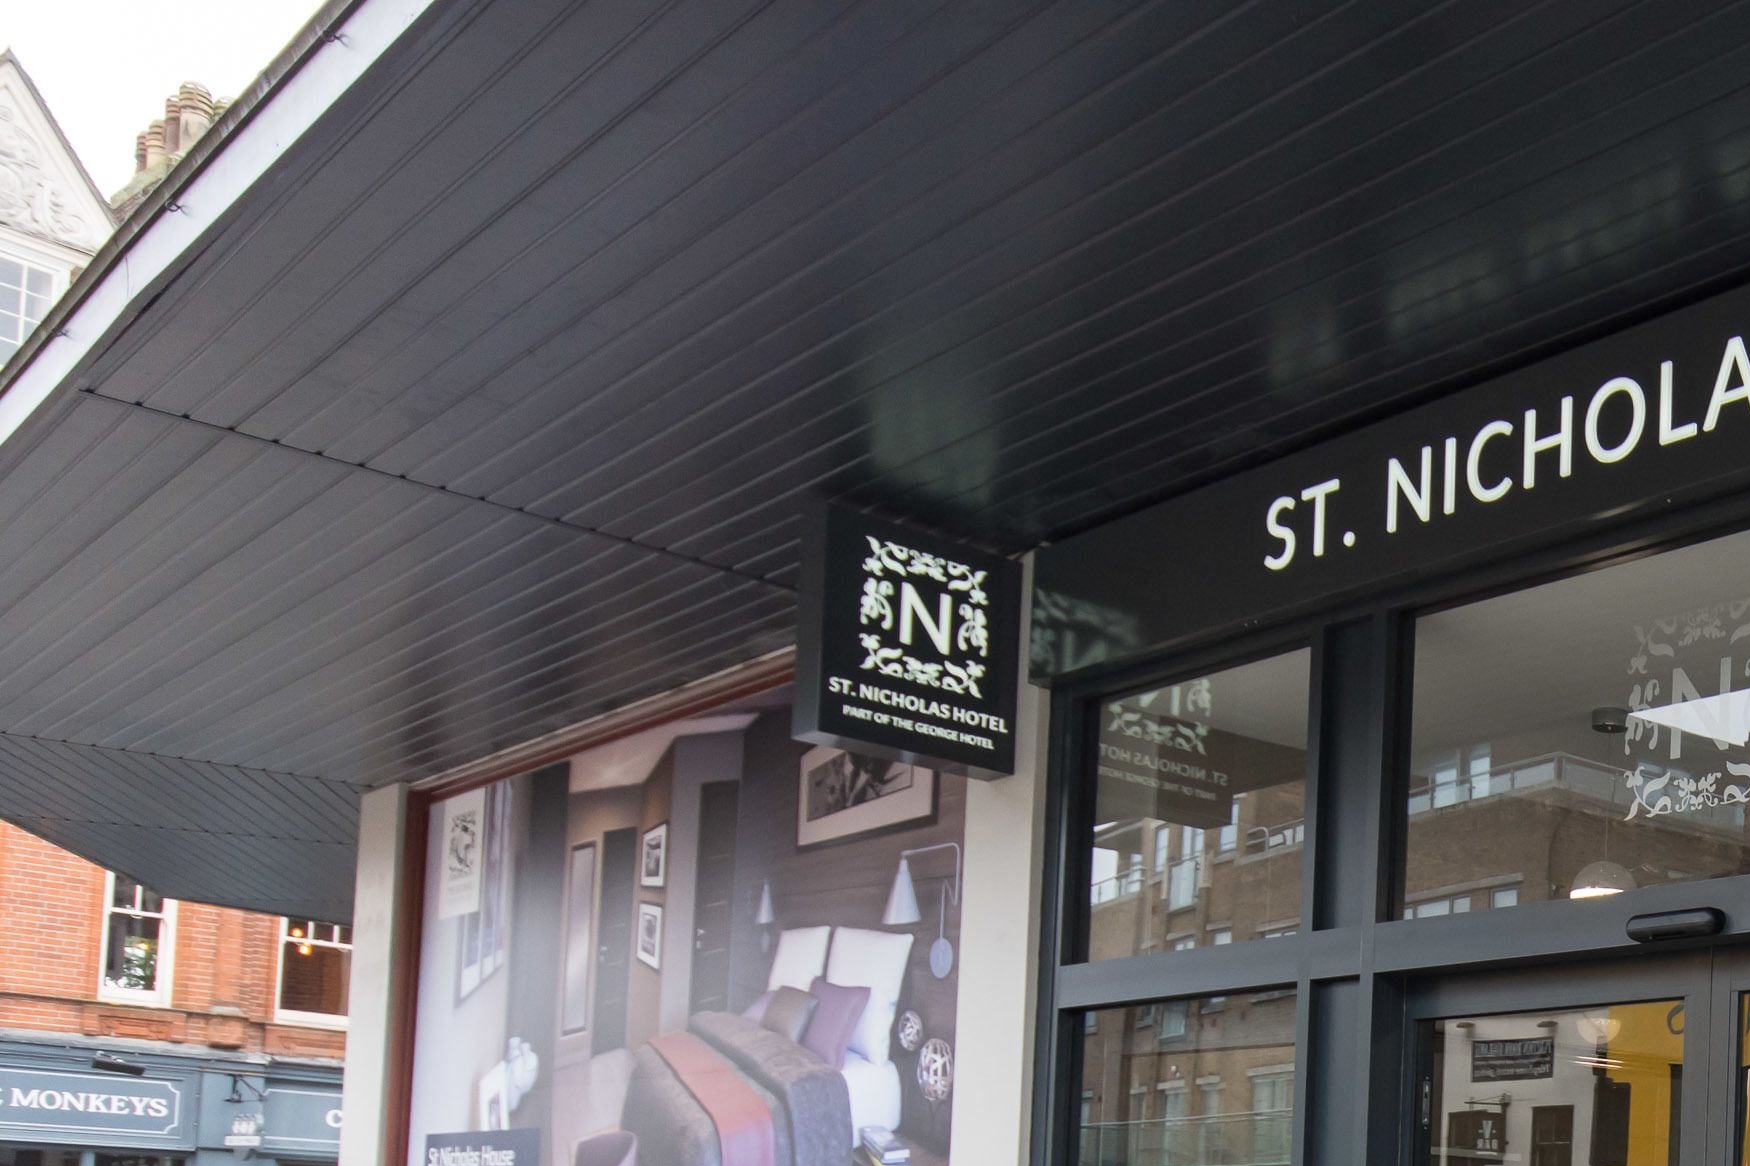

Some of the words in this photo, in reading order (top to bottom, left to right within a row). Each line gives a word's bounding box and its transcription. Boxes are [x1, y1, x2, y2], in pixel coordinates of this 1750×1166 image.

[1263, 477, 1356, 571] ST.
[828, 676, 857, 697] ST.
[859, 684, 951, 719] NICHOLAS
[953, 706, 1009, 734] HOTEL
[842, 704, 873, 722] PART
[874, 712, 891, 725] OF
[892, 716, 914, 732] THE
[915, 720, 958, 741] GEORGE
[959, 733, 994, 750] HOTEL
[10, 1087, 168, 1117] MONKEYS
[480, 1145, 515, 1166] House
